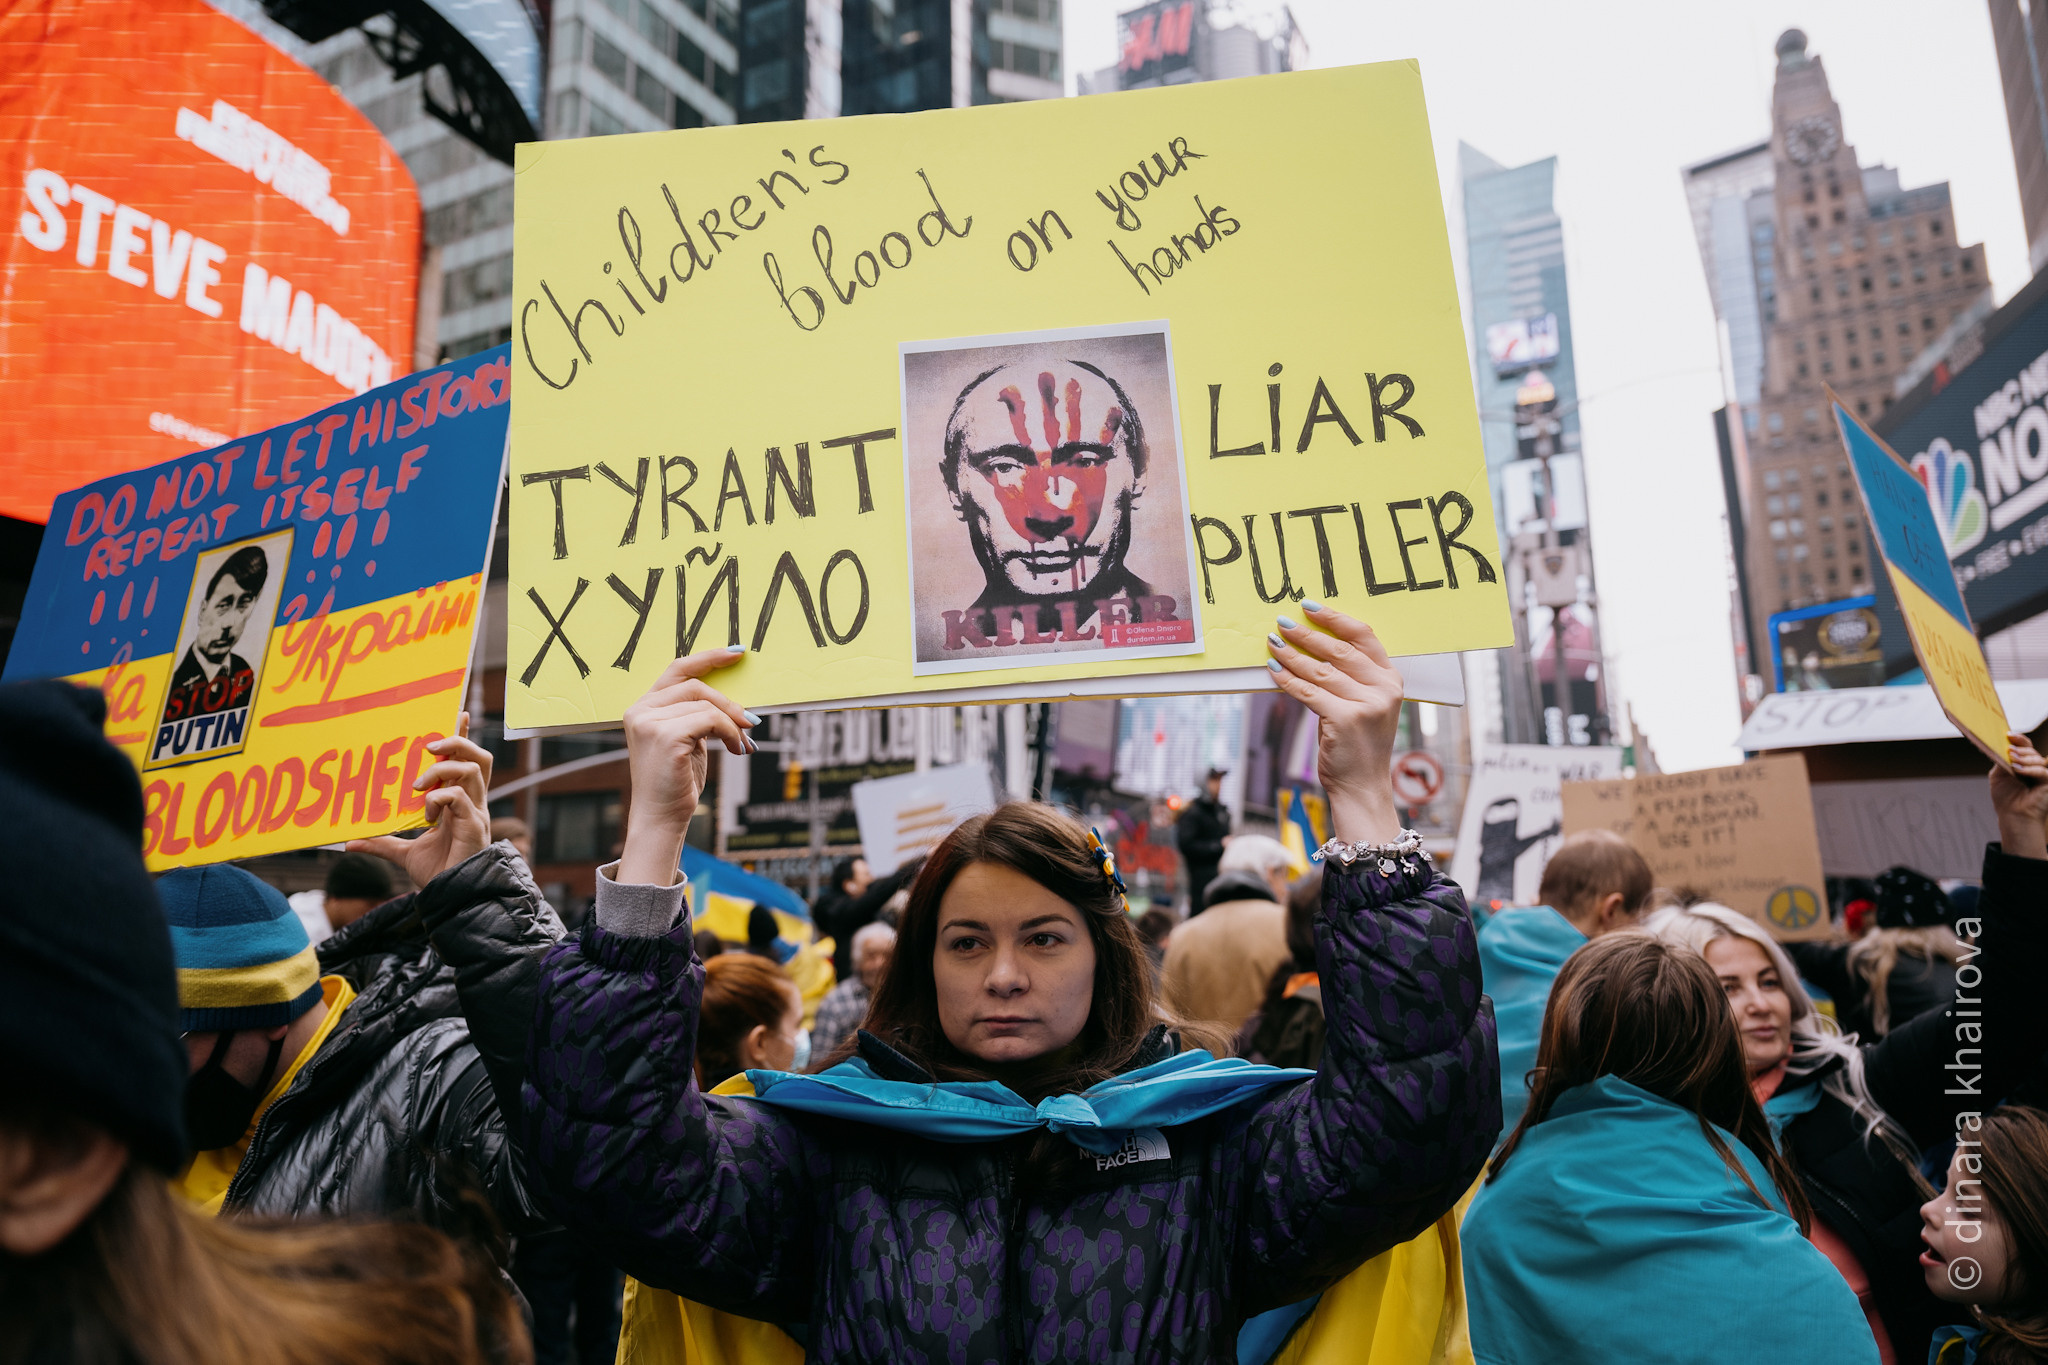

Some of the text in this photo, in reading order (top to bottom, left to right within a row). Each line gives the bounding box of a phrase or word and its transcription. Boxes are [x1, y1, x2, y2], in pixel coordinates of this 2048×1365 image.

[20, 168, 227, 318] STEVE
[521, 144, 849, 390] Children's
[762, 136, 1208, 331] blood on your
[1107, 193, 1241, 297] hands
[65, 484, 137, 546] DO
[145, 445, 246, 520] NOT
[253, 414, 348, 490] LET
[83, 444, 429, 581] REPEAT ITSELF
[520, 427, 896, 560] TYRANT
[1191, 490, 1497, 605] PUTLER
[941, 594, 1178, 650] KILLER
[152, 708, 248, 761] PUTIN
[166, 669, 254, 720] STOP
[1096, 1150, 1139, 1171] FACE
